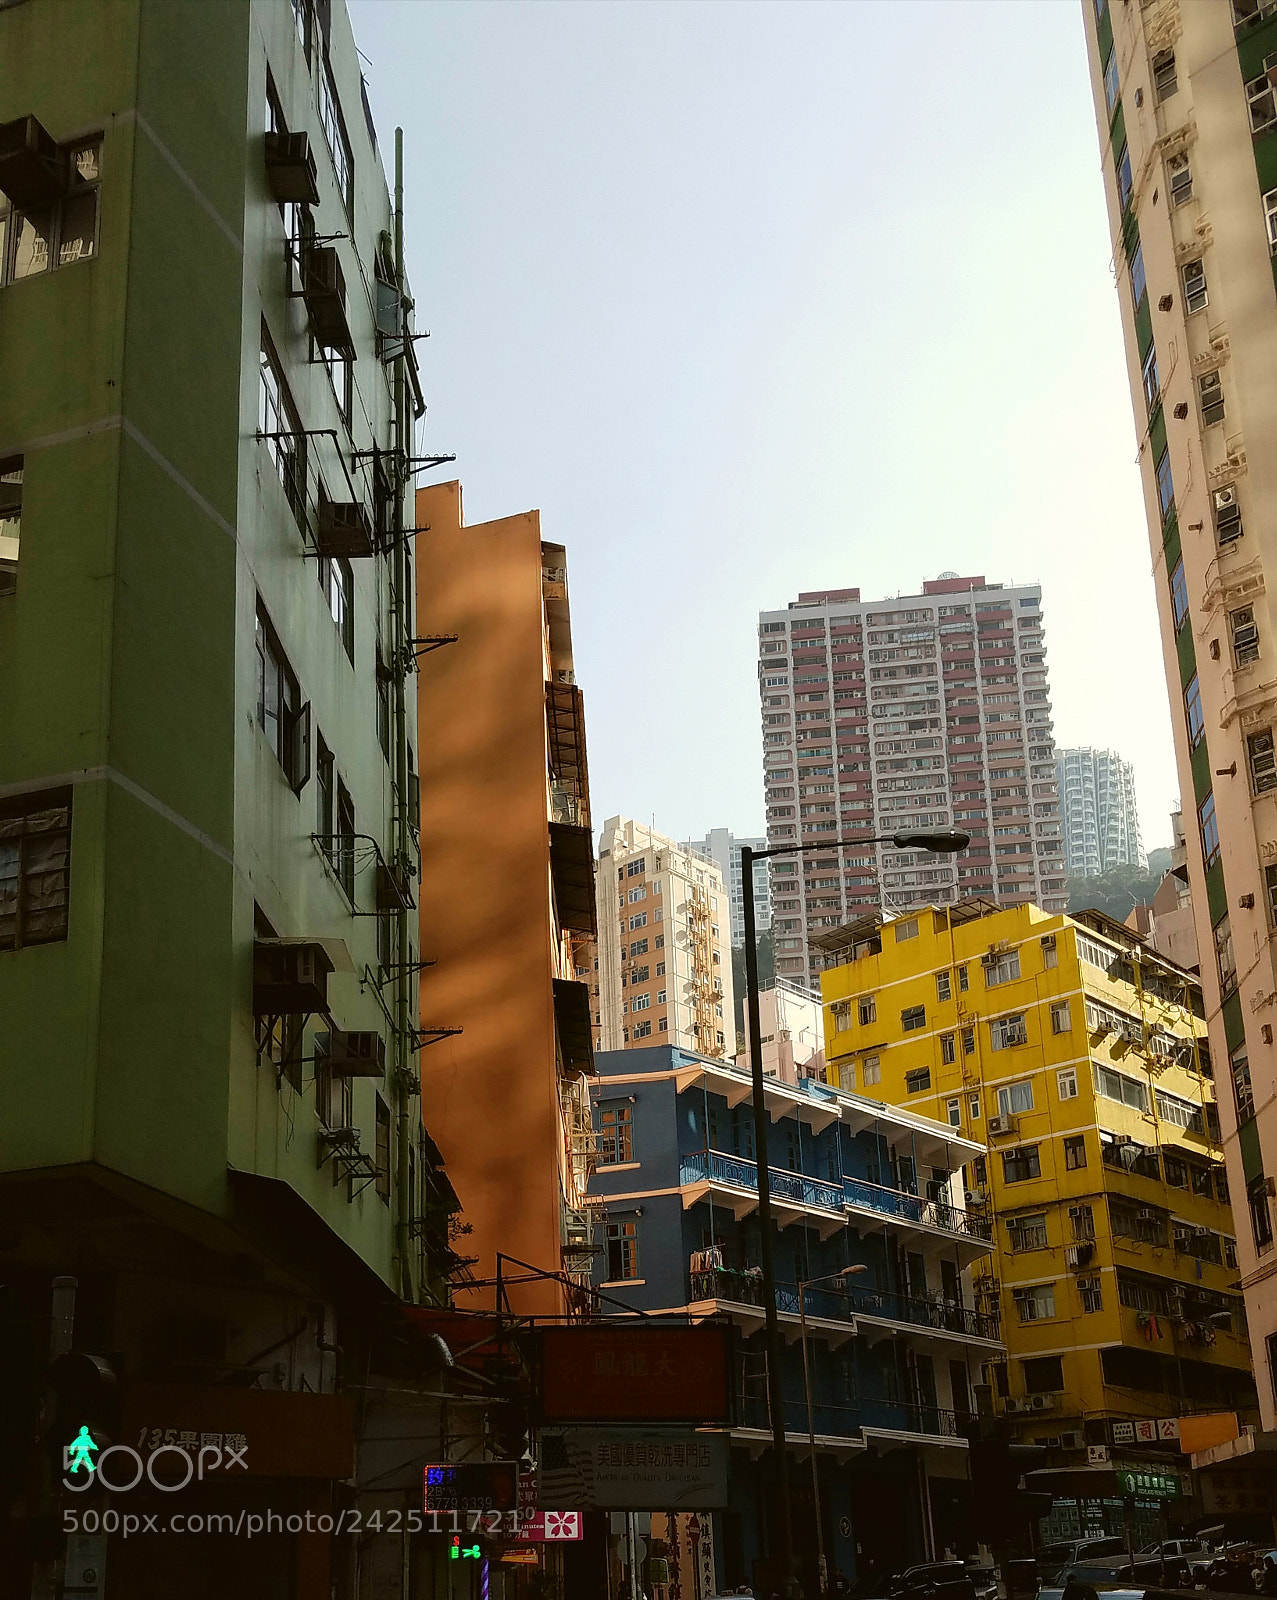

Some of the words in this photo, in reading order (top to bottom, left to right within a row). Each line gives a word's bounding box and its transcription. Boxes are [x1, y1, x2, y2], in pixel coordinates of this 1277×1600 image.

[597, 1442, 711, 1468] 美國優質乾洗專門店
